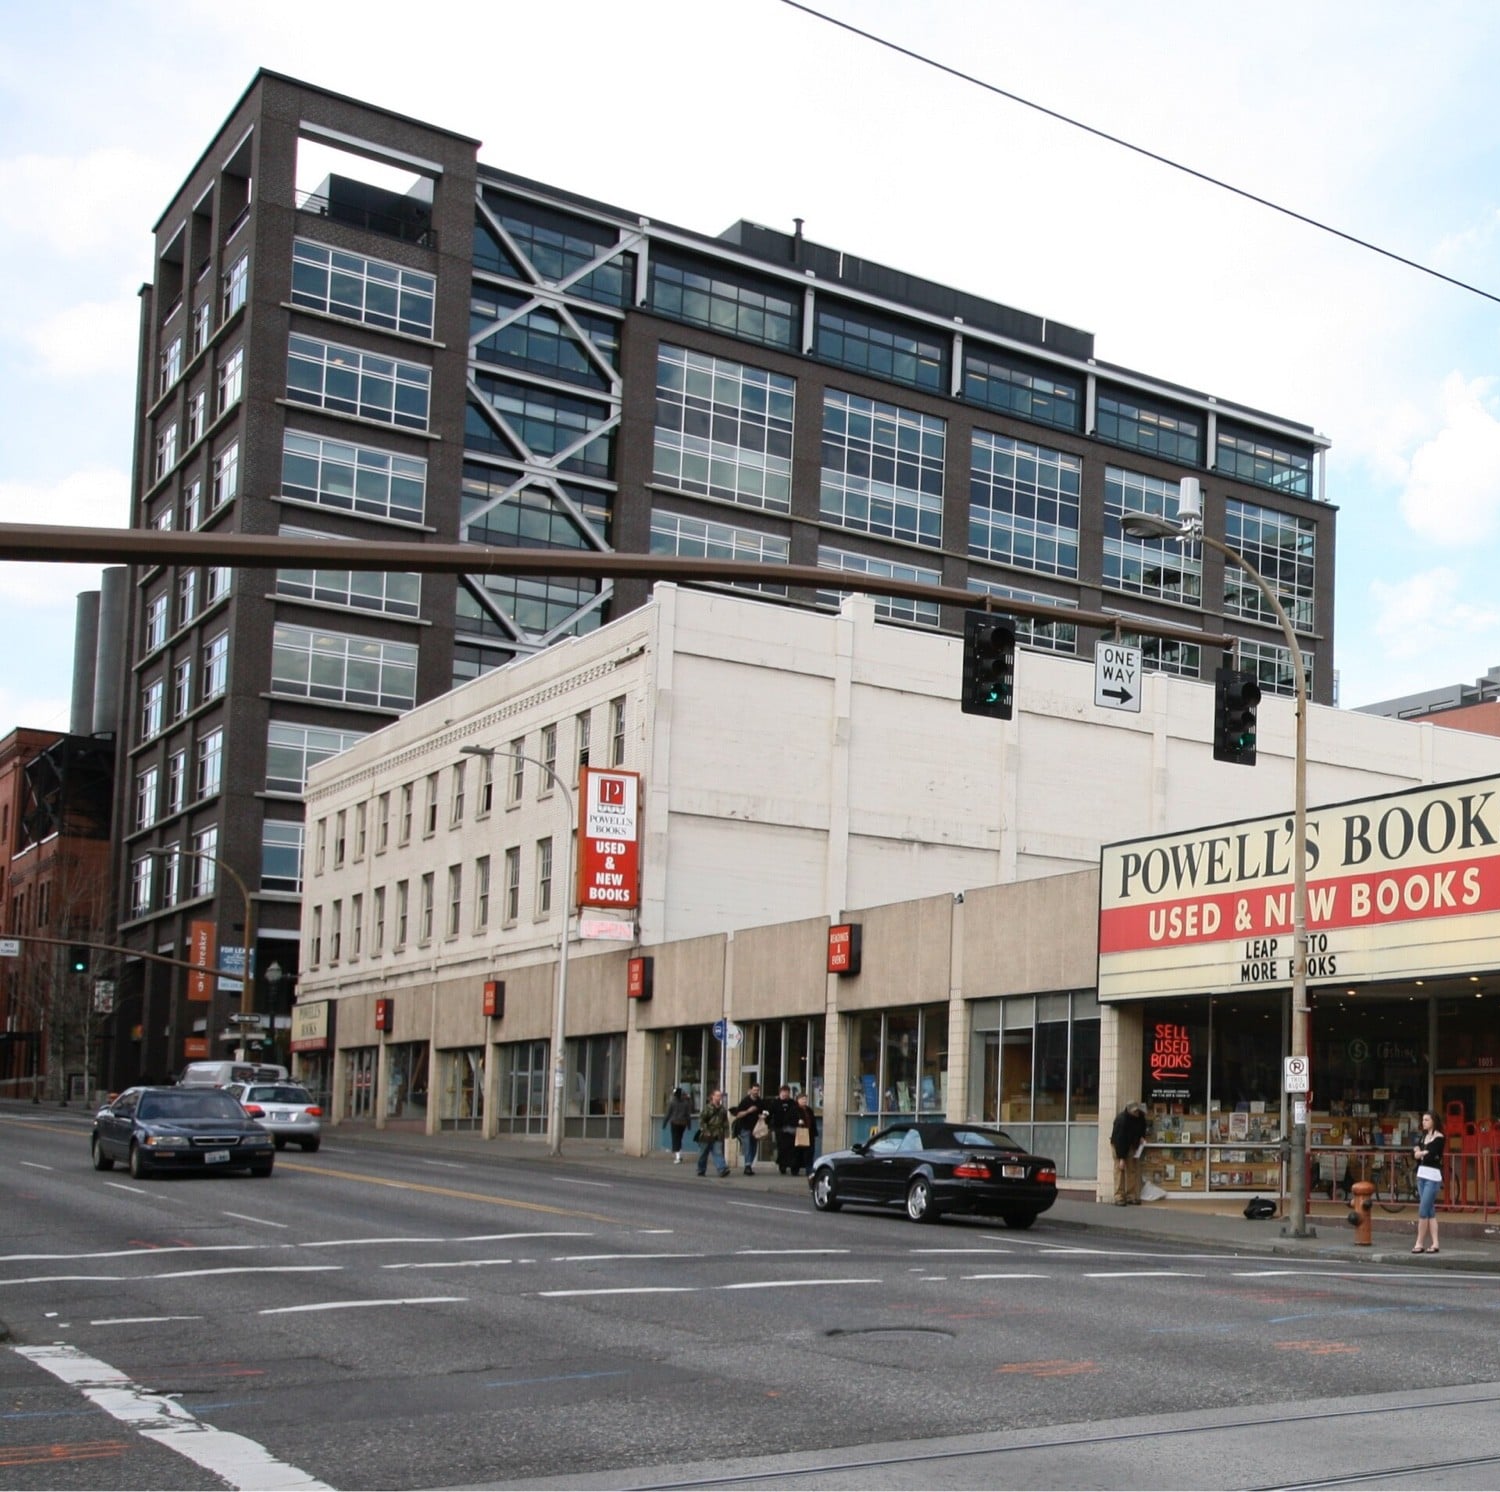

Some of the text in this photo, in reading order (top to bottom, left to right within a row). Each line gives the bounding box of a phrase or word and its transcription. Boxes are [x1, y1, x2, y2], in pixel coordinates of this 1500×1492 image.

[1104, 648, 1134, 667] ONE
[1103, 665, 1135, 684] WAY
[595, 825, 627, 836] BOOKS
[595, 841, 626, 855] USED
[604, 856, 616, 870] &
[595, 872, 624, 886] NEW
[588, 887, 630, 902] BOOKS
[1149, 902, 1221, 941] USED
[1234, 898, 1252, 932] &
[1350, 866, 1481, 918] BOOKS
[220, 946, 234, 954] FOR
[1245, 938, 1278, 960] LEAP
[831, 953, 846, 966] EVENTS
[1240, 960, 1278, 982] MORE
[1154, 1024, 1189, 1040] SELL
[1154, 1039, 1190, 1055] USED
[1150, 1052, 1193, 1069] BOOKS
[1288, 1082, 1306, 1090] BLOCK
